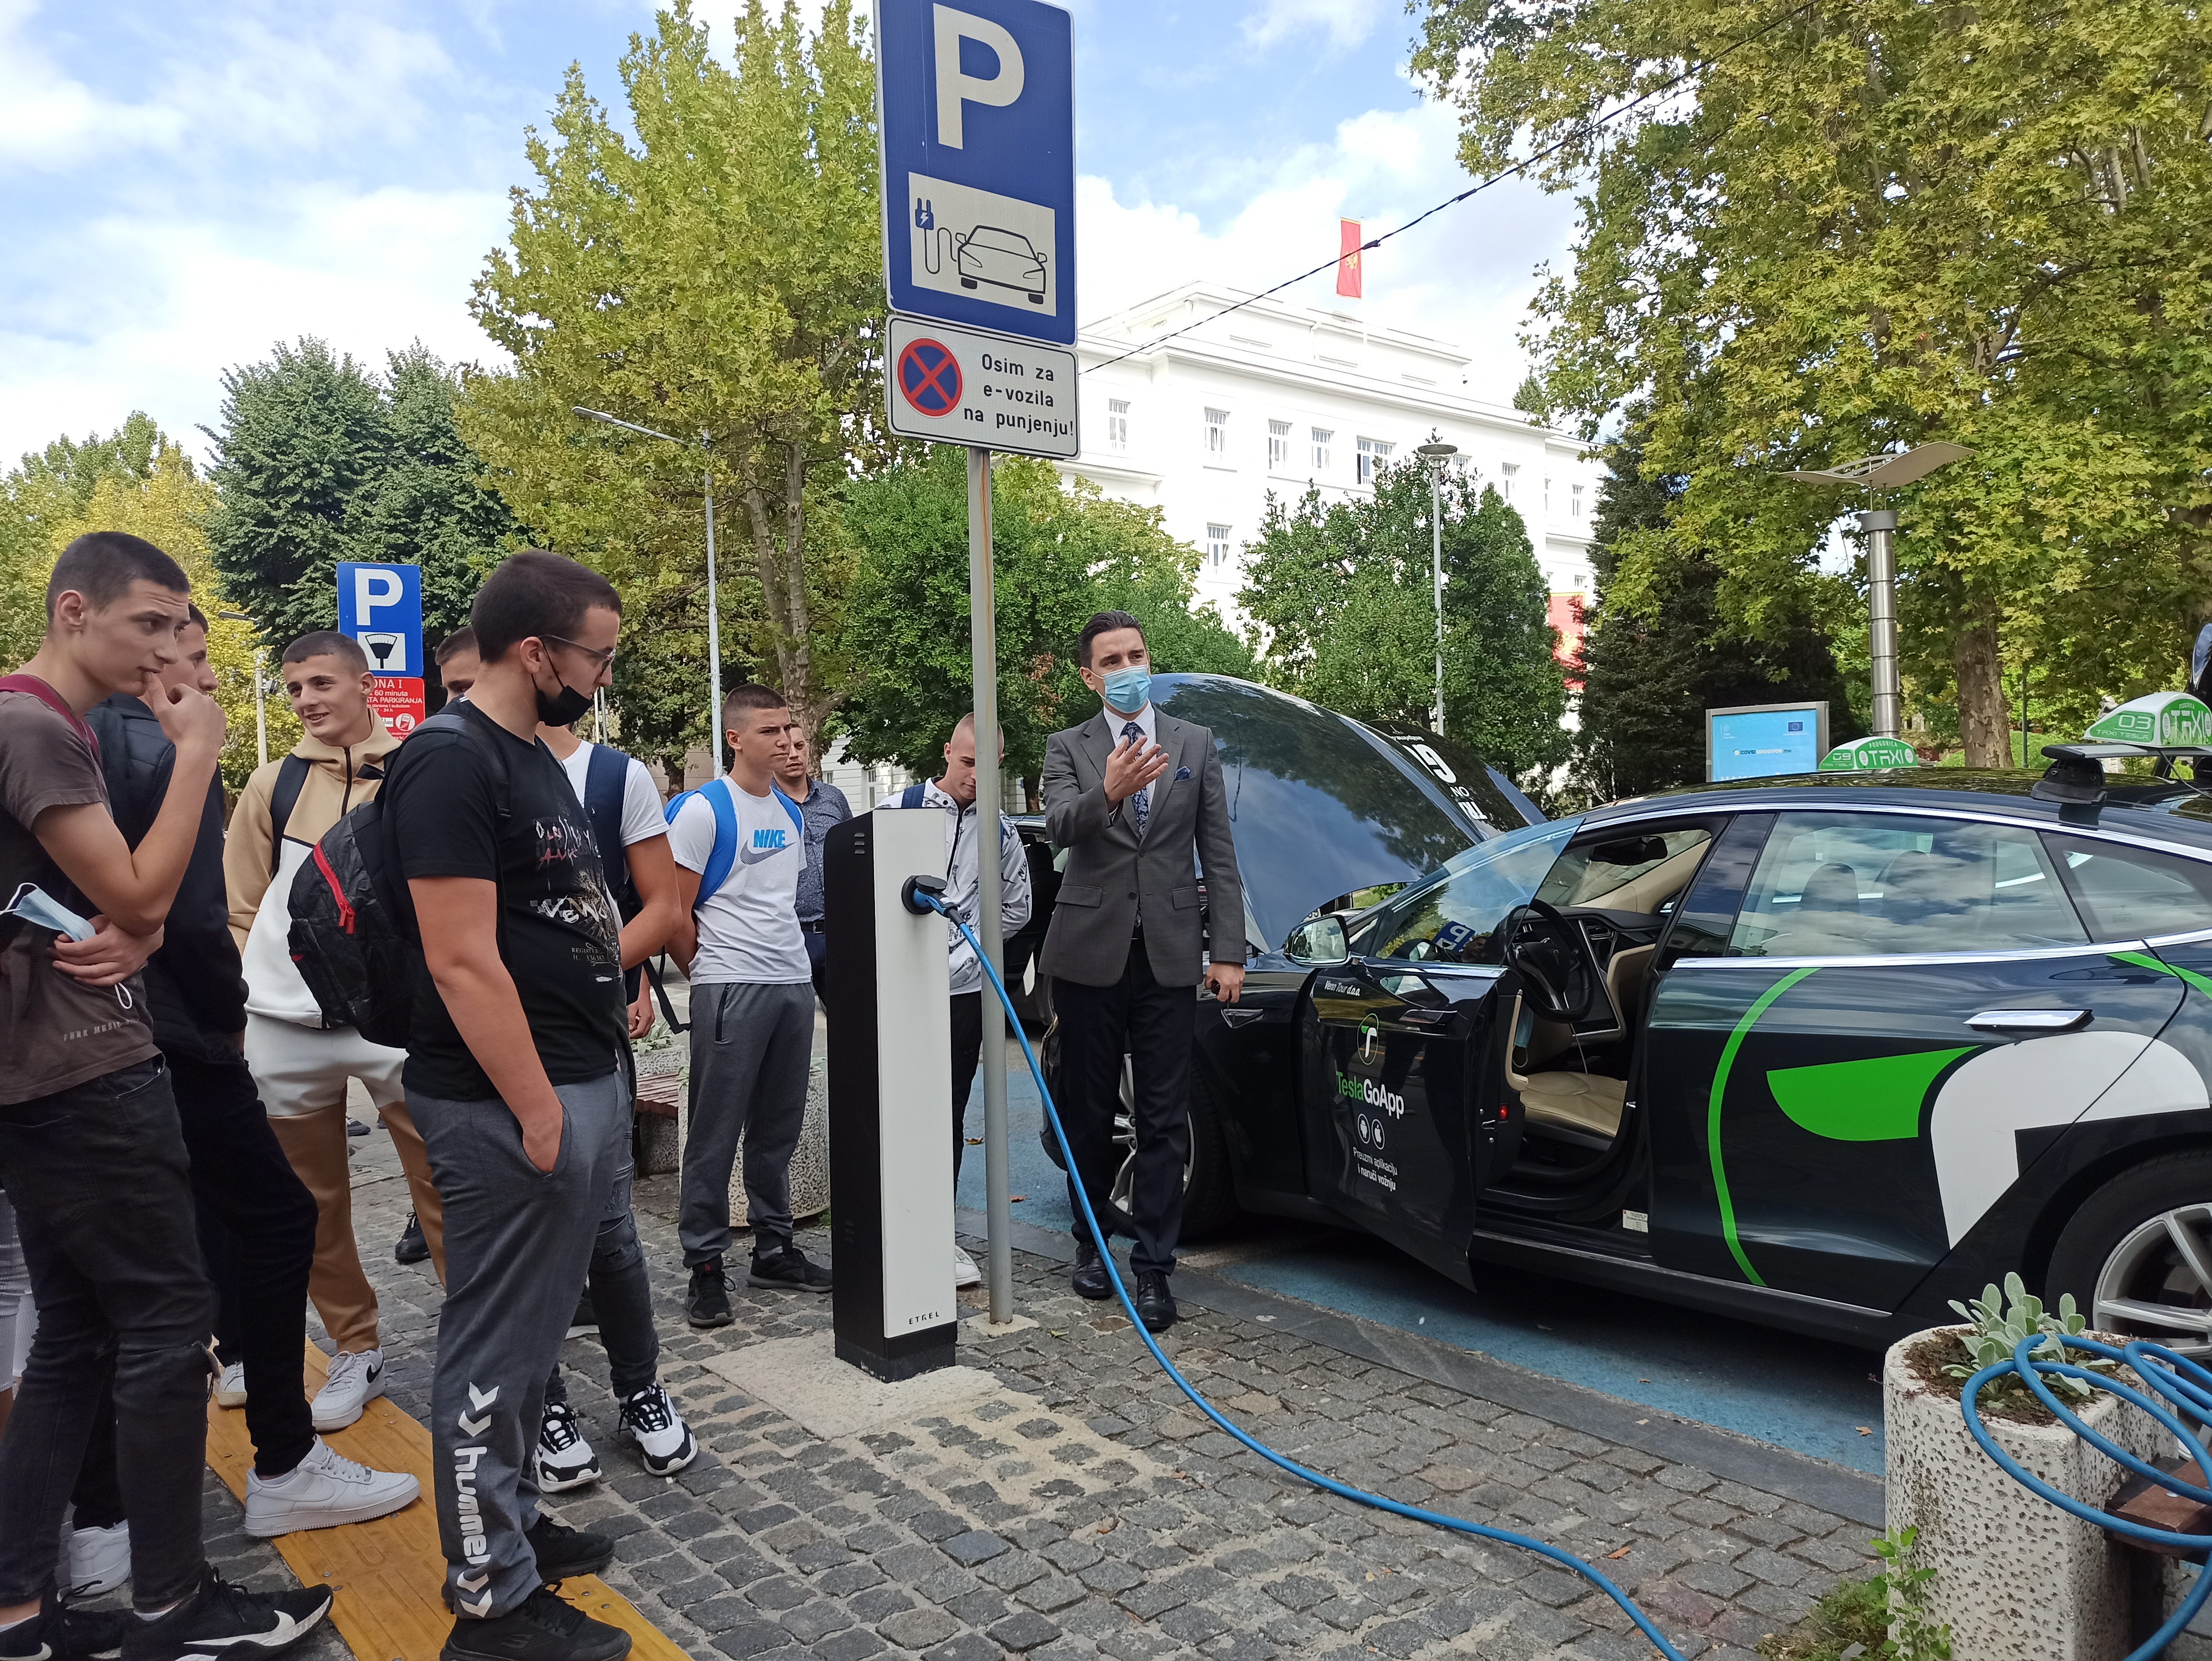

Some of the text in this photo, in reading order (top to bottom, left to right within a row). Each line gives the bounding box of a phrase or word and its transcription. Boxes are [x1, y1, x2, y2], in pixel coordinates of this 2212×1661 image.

[933, 2, 1025, 150] P
[982, 354, 1054, 381] Osim za
[984, 385, 1054, 407] e-vozila
[964, 408, 1073, 437] na punjenju!
[355, 568, 403, 626] P
[2118, 714, 2151, 730] 03
[1869, 741, 1898, 749] PODGORICA
[2120, 731, 2149, 740] TESLA
[753, 829, 785, 848] NIKE
[1324, 980, 1360, 996] Venn Tour d.o.o.
[1336, 1071, 1405, 1120] TeslaGoApp
[1353, 1146, 1398, 1176] Preuzmi aplikaciju
[1360, 1167, 1377, 1182] naruči
[1377, 1174, 1396, 1192] vožnju
[909, 1311, 940, 1325] ETREL
[454, 1446, 492, 1565] hummel
